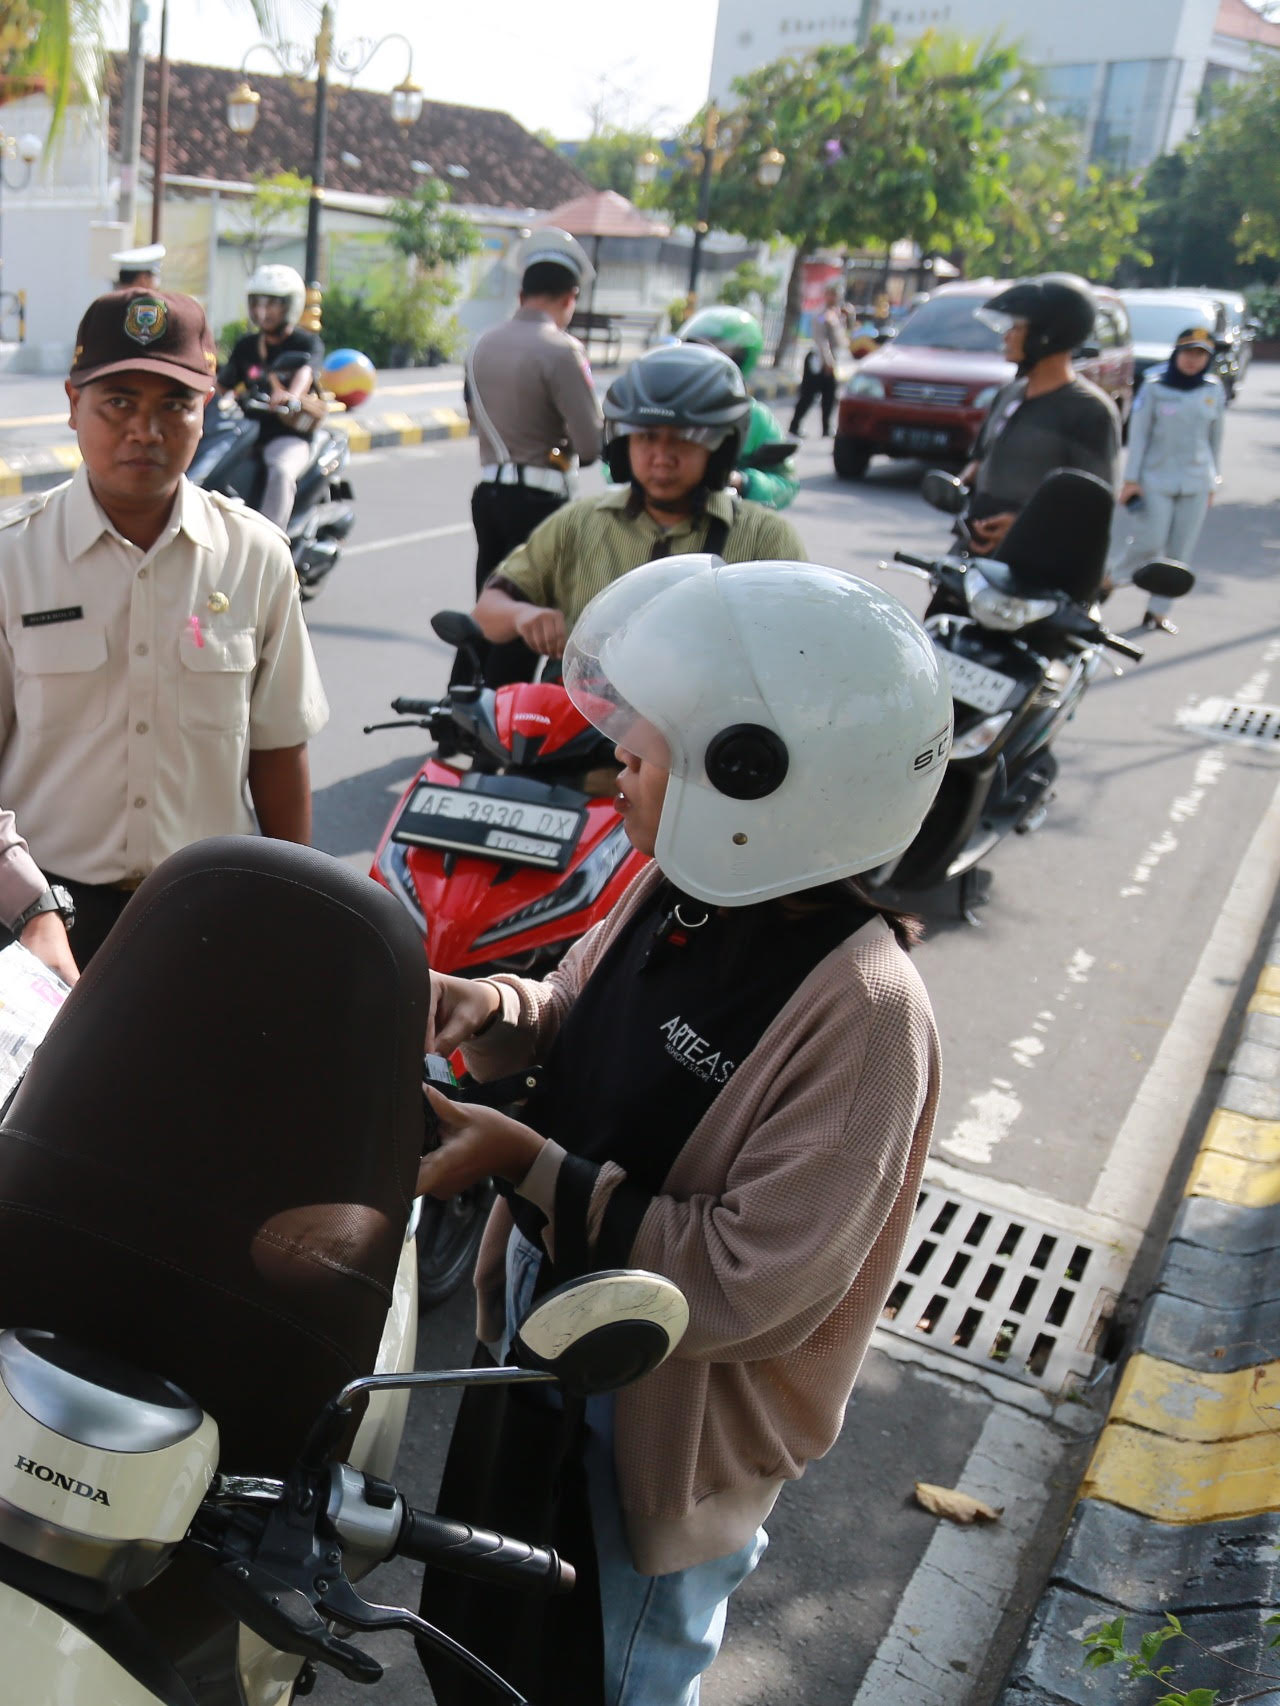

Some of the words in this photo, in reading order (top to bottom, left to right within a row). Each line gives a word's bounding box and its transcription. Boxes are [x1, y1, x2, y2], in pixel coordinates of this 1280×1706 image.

[464, 801, 524, 829] 3930
[535, 812, 572, 840] DX
[14, 1454, 111, 1507] HONDA
